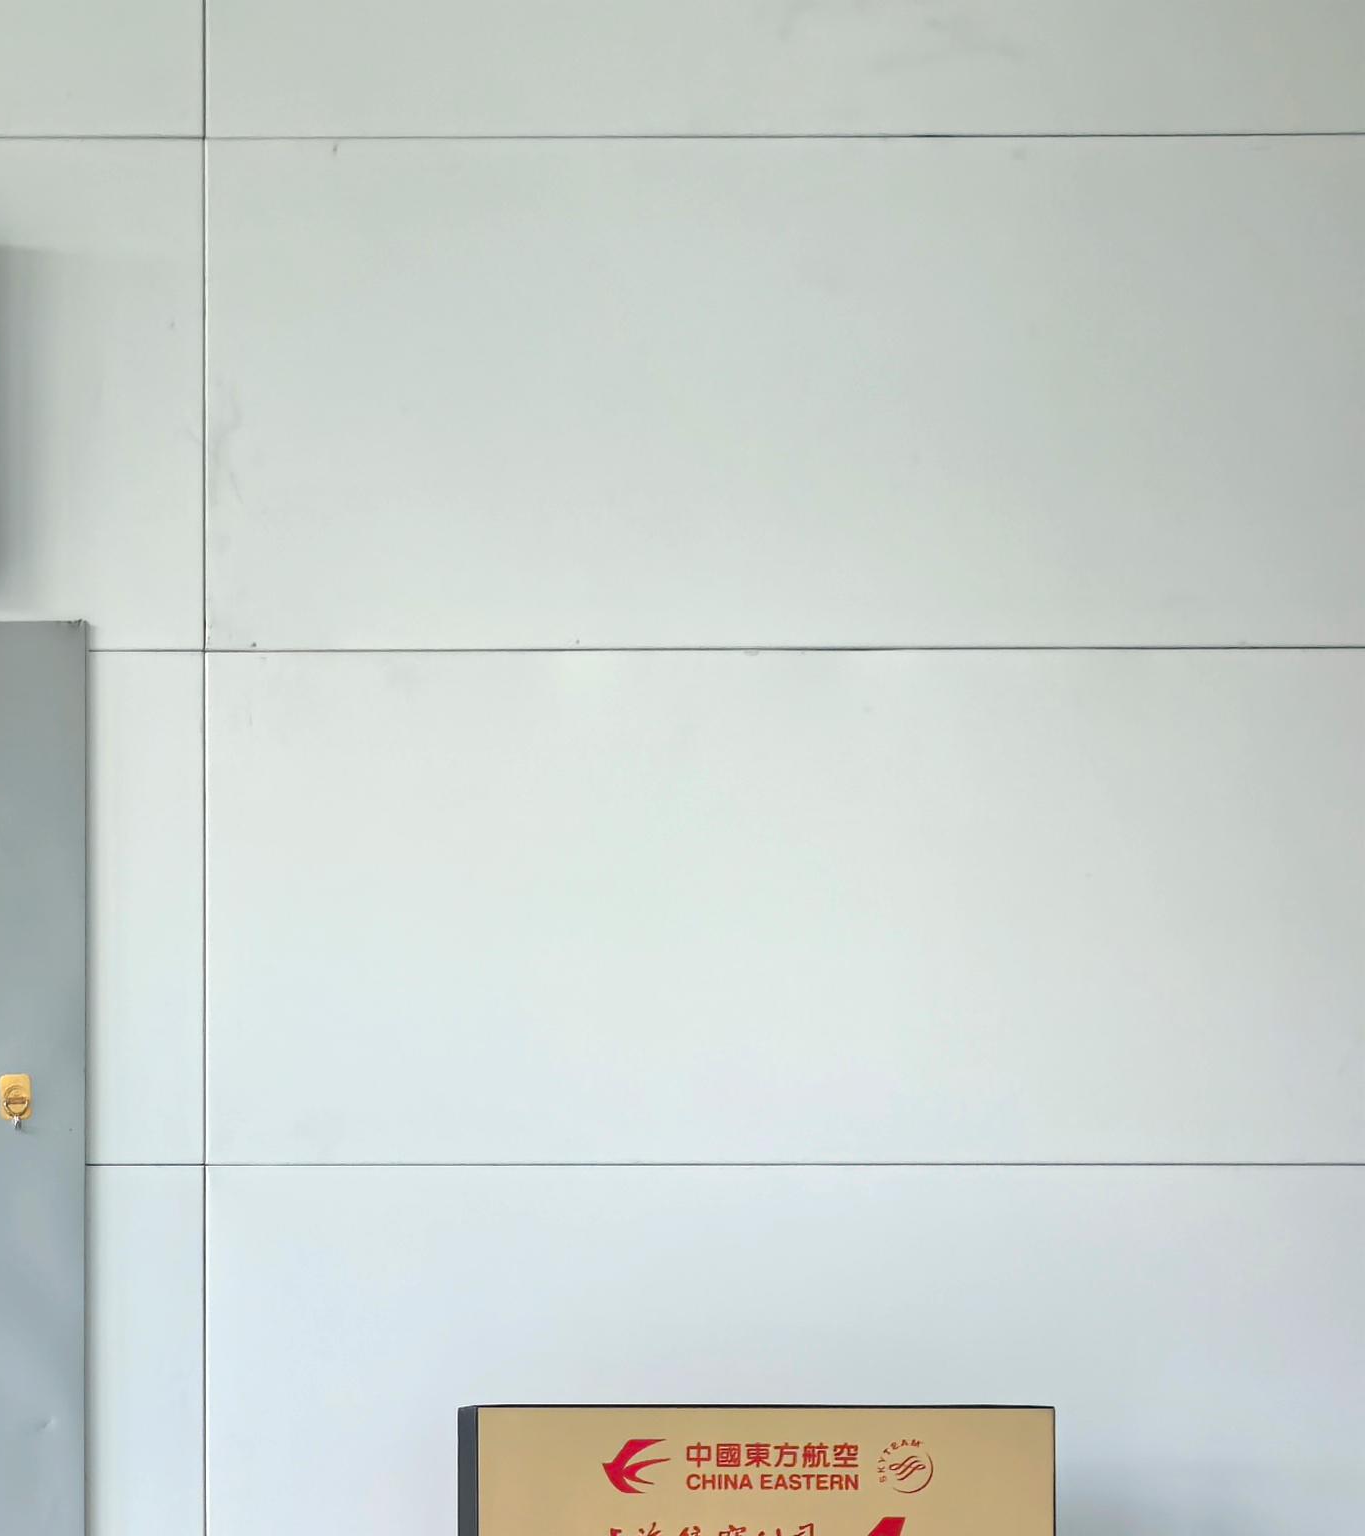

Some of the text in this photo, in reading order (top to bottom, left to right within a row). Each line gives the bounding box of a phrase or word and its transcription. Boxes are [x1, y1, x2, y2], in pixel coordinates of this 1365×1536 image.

[686, 1442, 859, 1468] 中國東方航空
[686, 1474, 859, 1491] CHINA EASTERN
